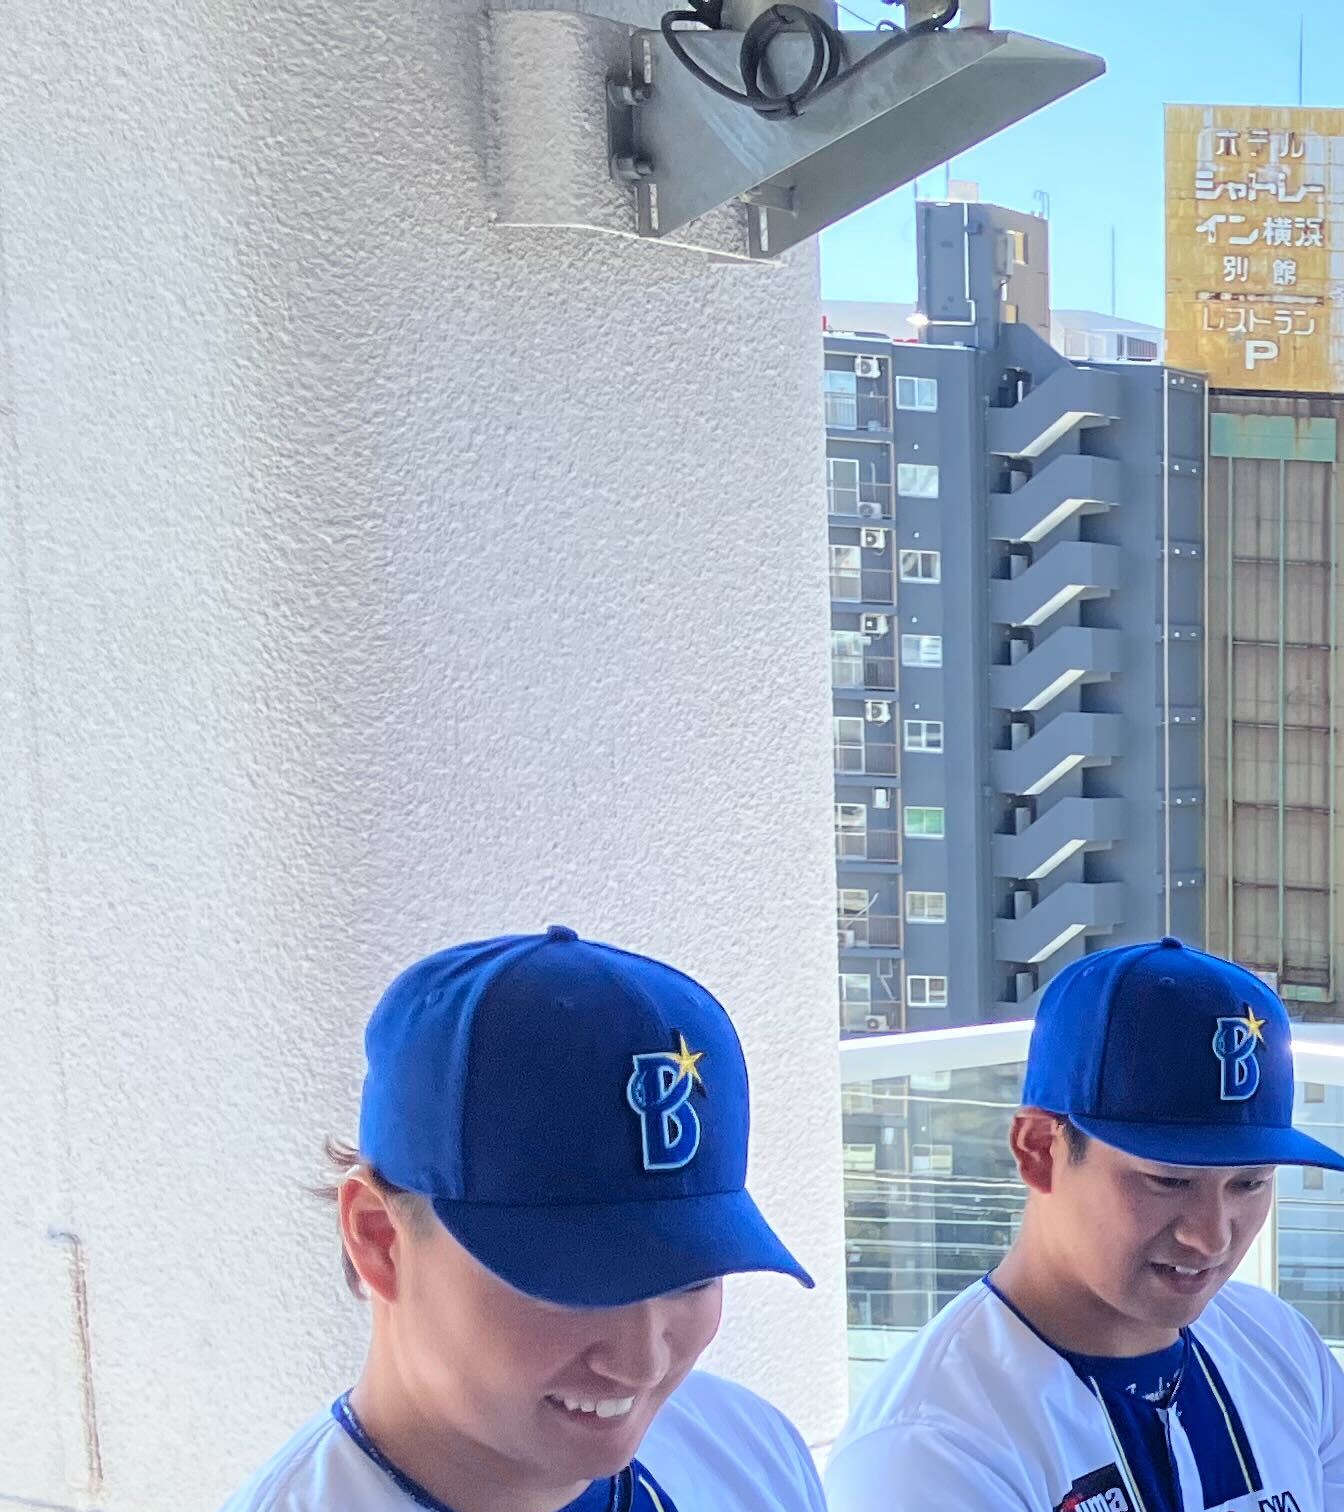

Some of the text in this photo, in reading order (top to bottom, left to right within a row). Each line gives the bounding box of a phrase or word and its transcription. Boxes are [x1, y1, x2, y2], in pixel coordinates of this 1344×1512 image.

[1216, 131, 1304, 157] ホテル
[1196, 214, 1324, 247] イン横浜
[1203, 306, 1315, 335] レストラン
[1244, 340, 1279, 370] P
[1212, 1017, 1260, 1101] B
[626, 1051, 701, 1171] B
